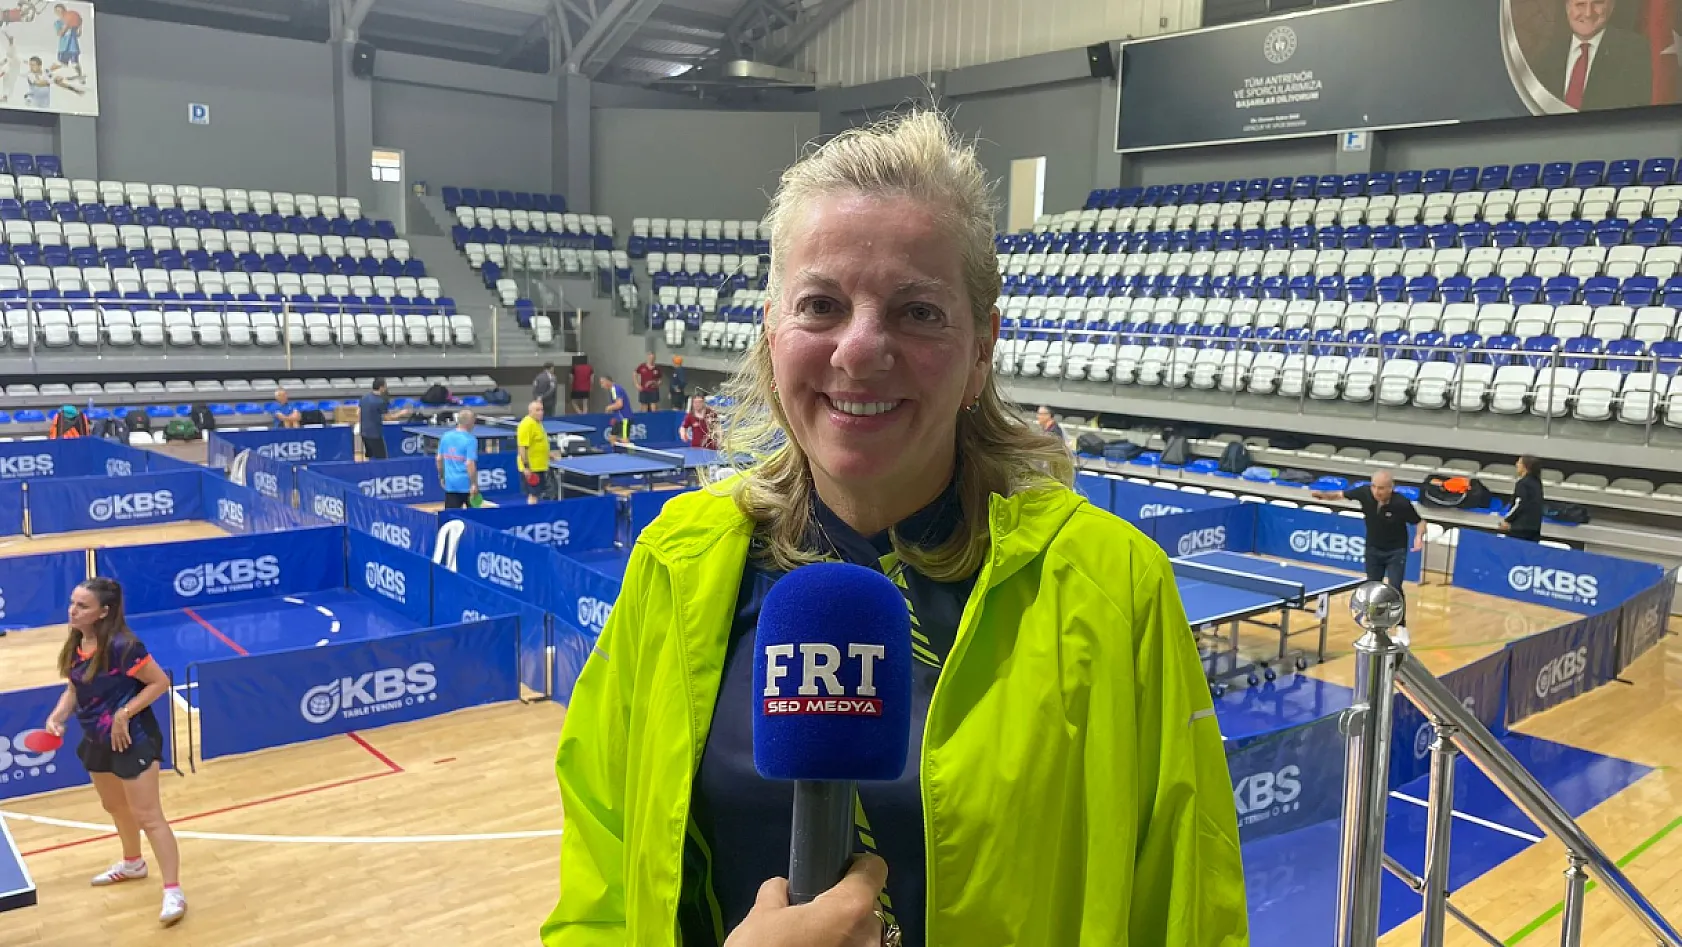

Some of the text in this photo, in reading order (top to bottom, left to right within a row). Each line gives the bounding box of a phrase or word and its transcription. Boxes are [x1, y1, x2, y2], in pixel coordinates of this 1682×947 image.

[193, 105, 206, 120] D
[274, 440, 316, 457] KBS
[0, 454, 54, 474] KBS
[261, 472, 278, 492] KBS
[377, 475, 424, 496] KBS
[477, 468, 507, 487] BS
[114, 490, 174, 512] KBS
[225, 500, 244, 523] KBS
[324, 496, 344, 518] KBS
[383, 523, 411, 549] KBS
[1192, 526, 1226, 549] KBS
[1311, 530, 1366, 556] KBS
[205, 555, 280, 587] KBS
[376, 563, 406, 596] KBS
[494, 552, 524, 584] KBS
[1533, 566, 1599, 598] KBS
[764, 643, 885, 697] FRT
[1549, 645, 1588, 682] KBS
[341, 662, 437, 709] KBS
[343, 700, 403, 719] TABLE TENNIS
[768, 700, 877, 713] SED MEDYA
